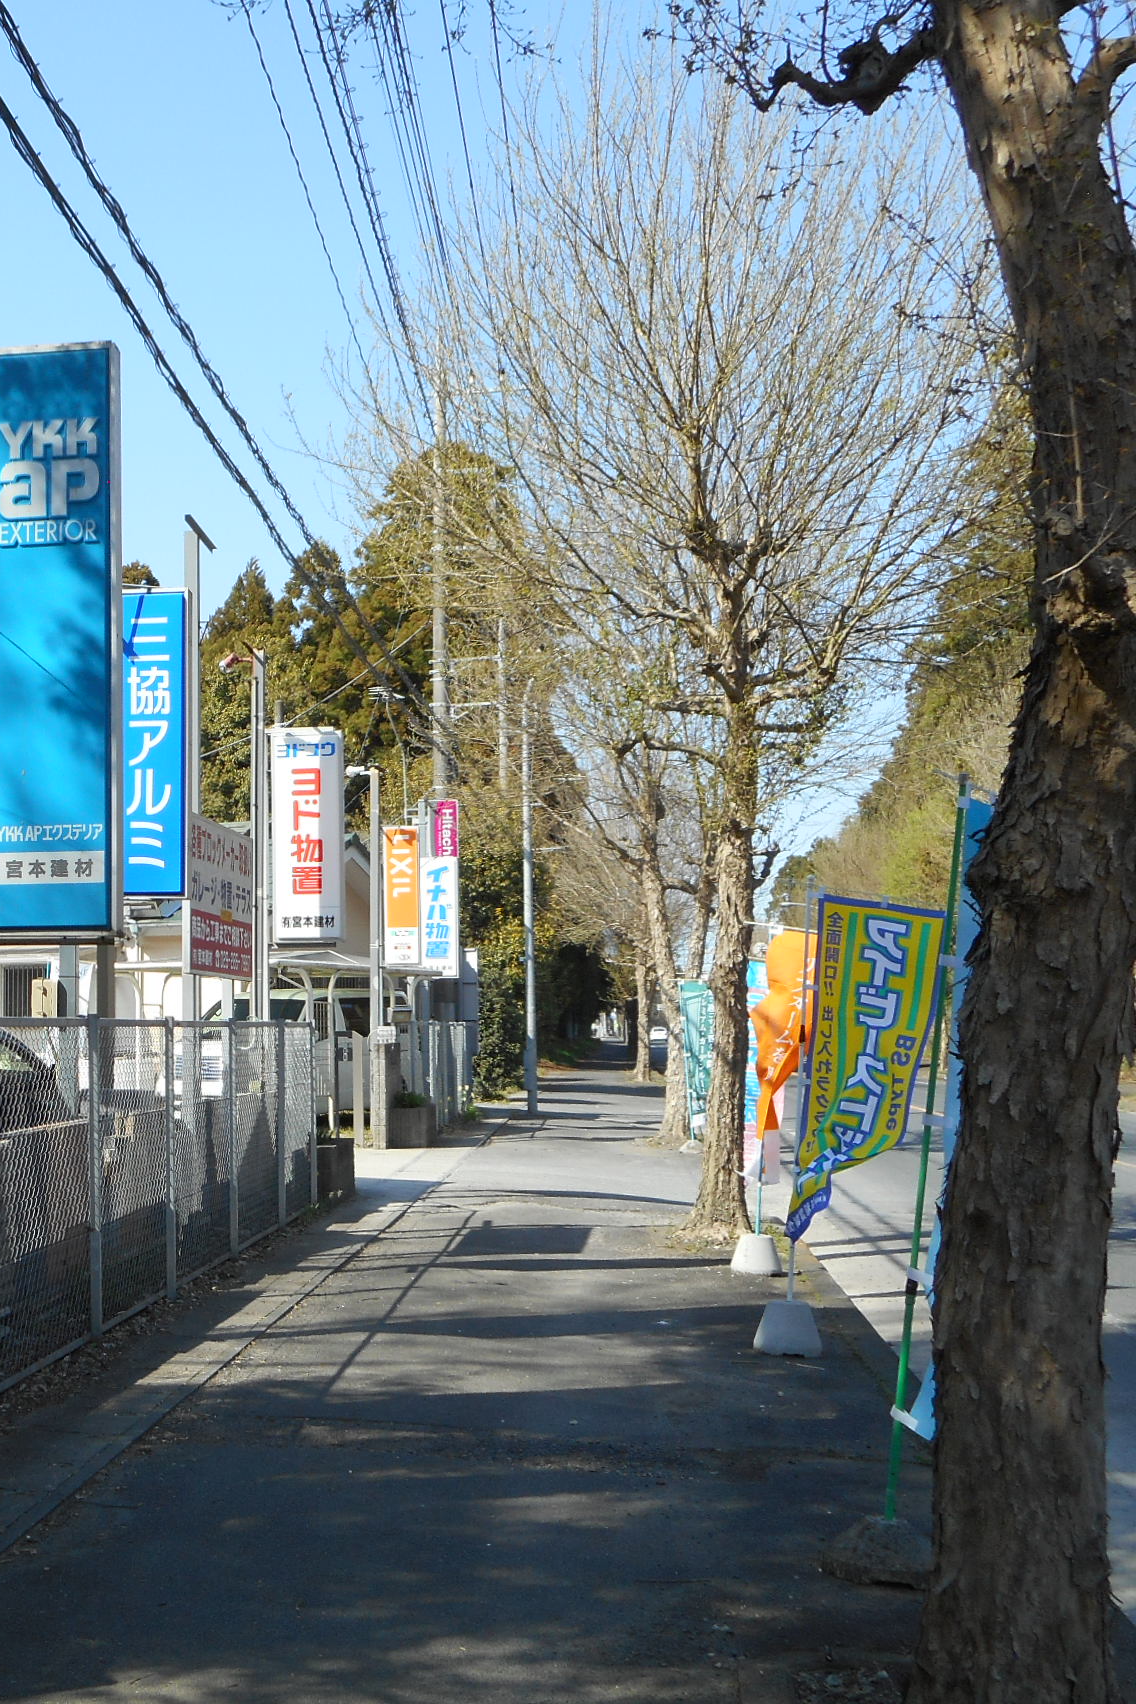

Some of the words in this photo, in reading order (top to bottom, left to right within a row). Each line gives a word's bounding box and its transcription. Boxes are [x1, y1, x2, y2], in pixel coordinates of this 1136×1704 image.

[127, 616, 172, 870] 三協アルミ
[276, 742, 336, 758] ヨドコウ
[5, 858, 94, 878] 宮本建材
[291, 767, 324, 895] ヨド物置
[389, 834, 413, 898] LIXIL
[425, 866, 451, 959] イナバ物置
